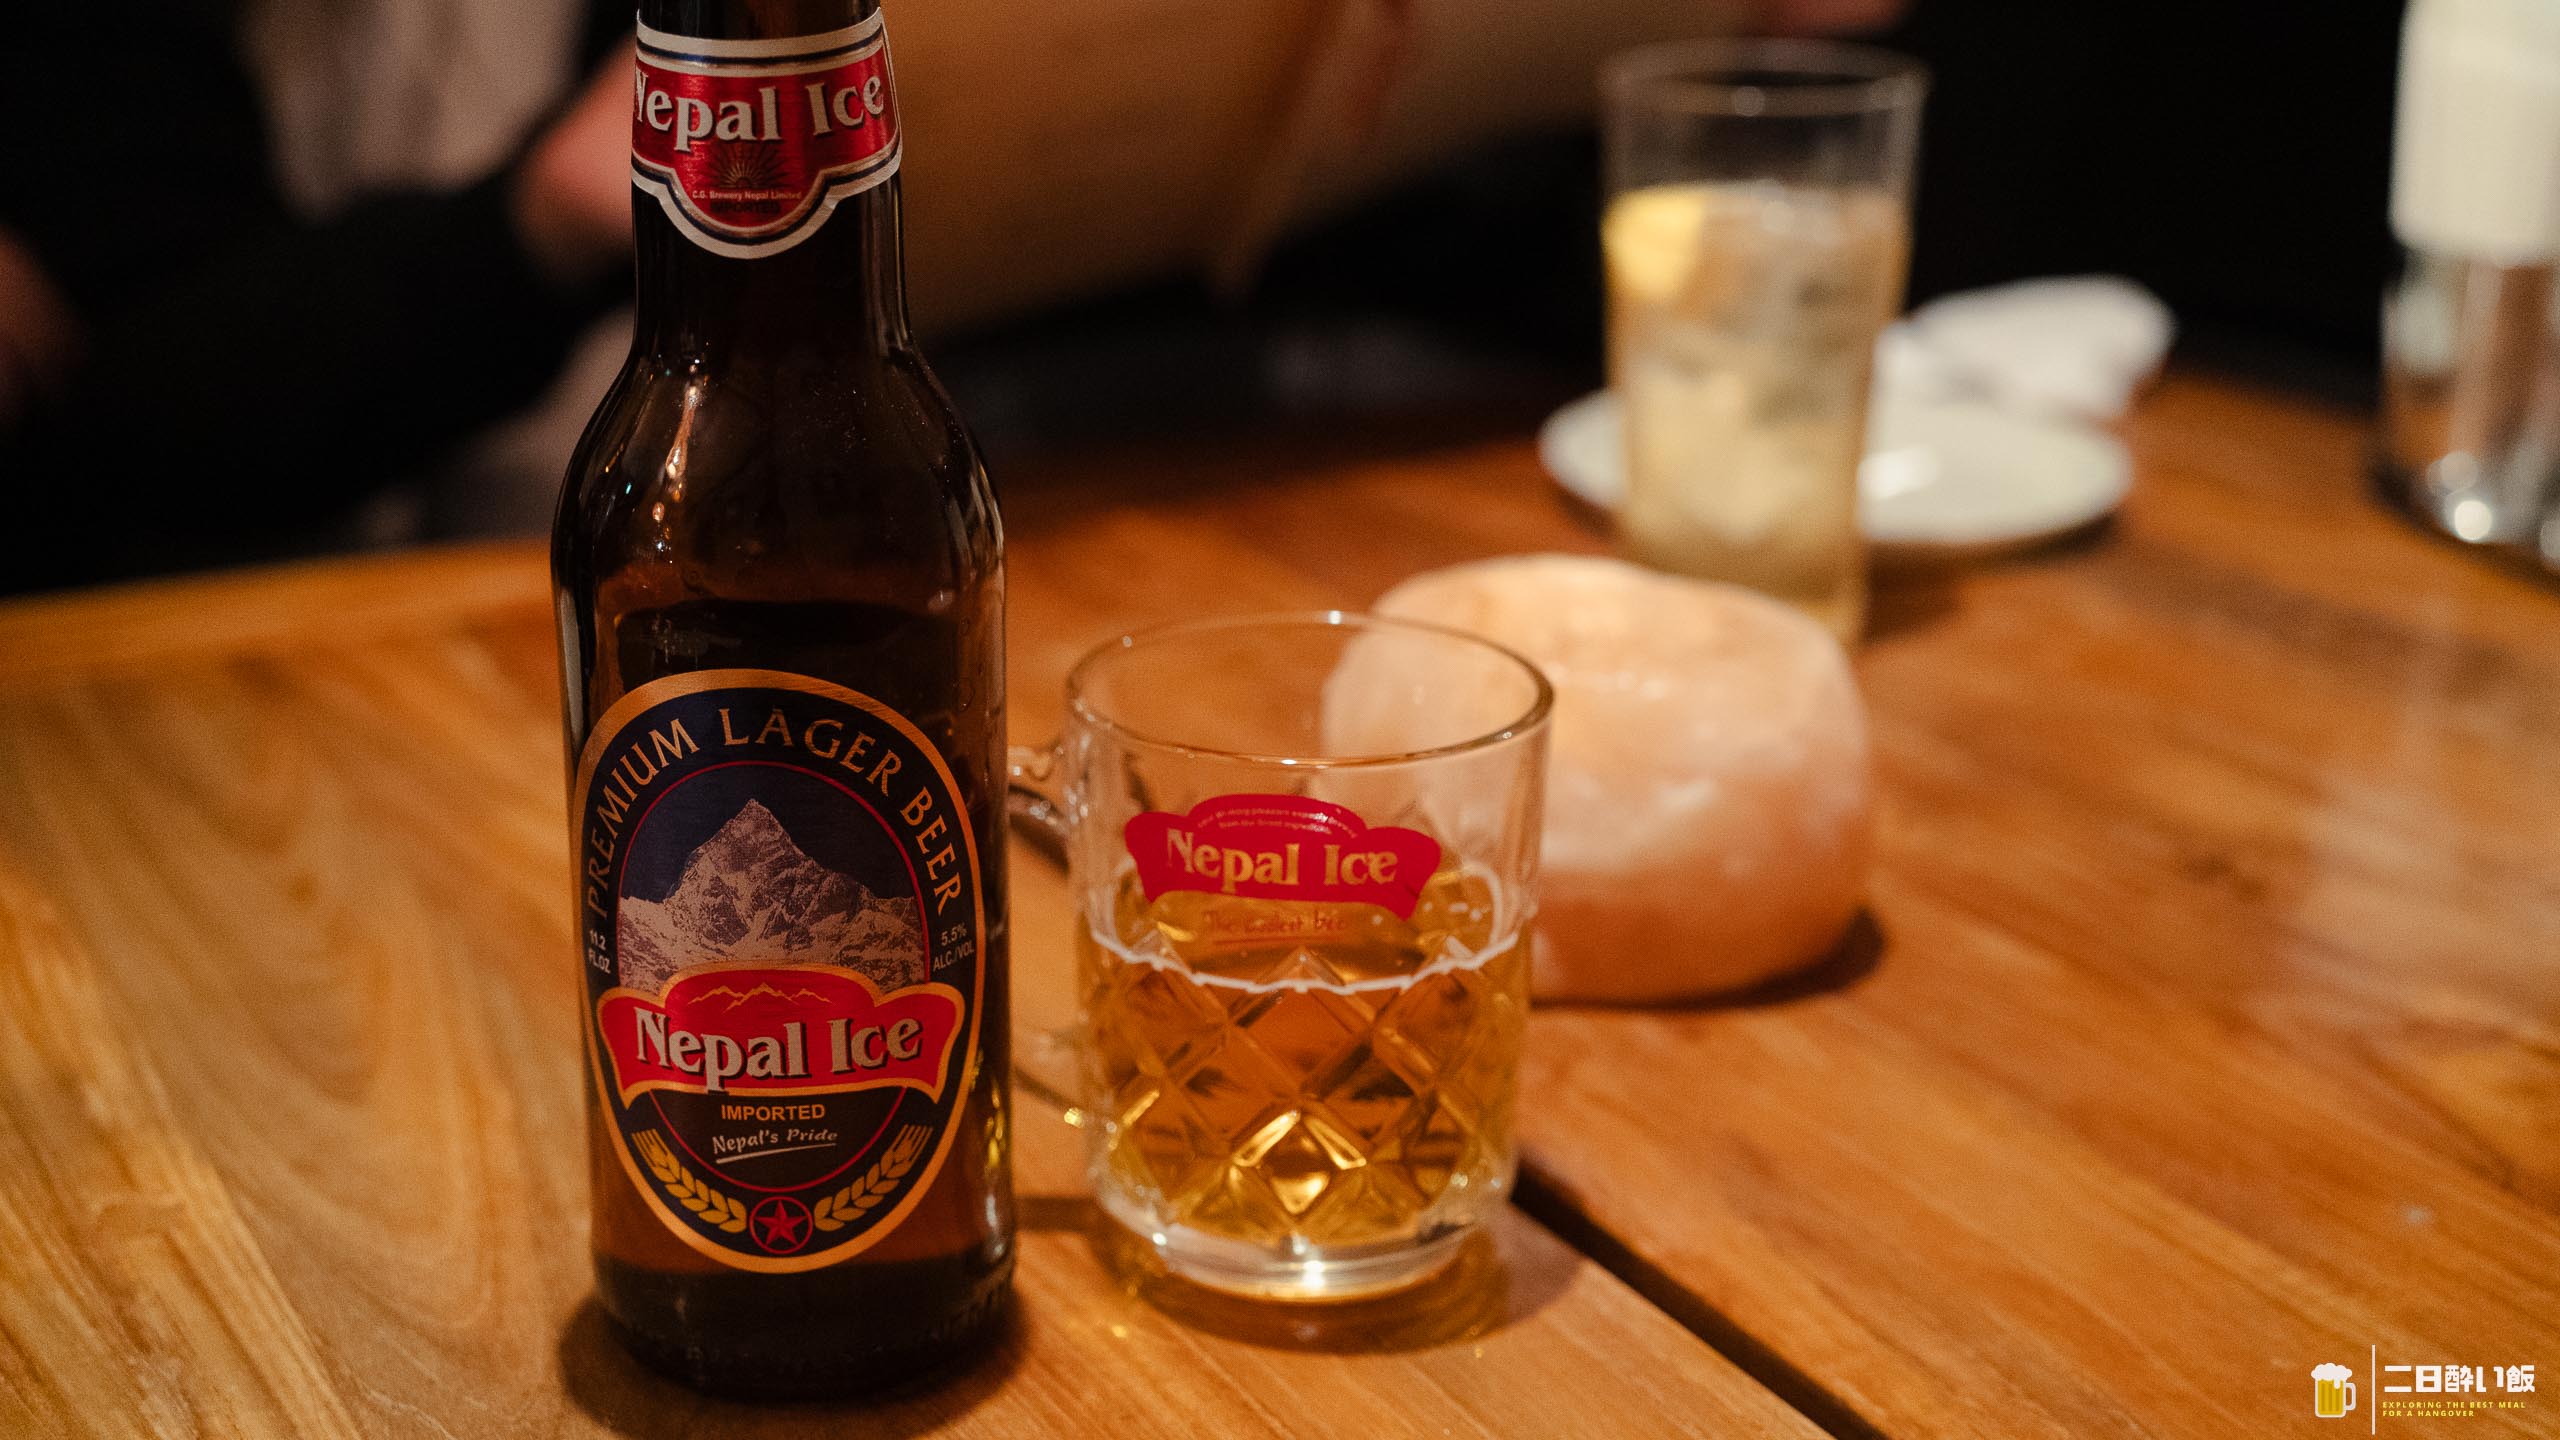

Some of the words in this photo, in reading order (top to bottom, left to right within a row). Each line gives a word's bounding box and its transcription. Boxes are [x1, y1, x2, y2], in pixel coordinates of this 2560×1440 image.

[805, 74, 884, 136] Ice
[709, 190, 742, 201] Brewery
[744, 190, 769, 201] Nepal
[587, 718, 701, 918] PREMIUM
[718, 707, 902, 797] LAGER
[901, 785, 962, 916] BEER
[1166, 827, 1300, 895] Nepal
[1323, 843, 1399, 886] Ice
[941, 922, 967, 946] 5.5%
[634, 1006, 810, 1093] Nepal
[828, 1015, 923, 1074] Ice
[721, 1103, 826, 1121] IMPORTED
[712, 1129, 779, 1155] Nepal's
[787, 1128, 838, 1142] Pride
